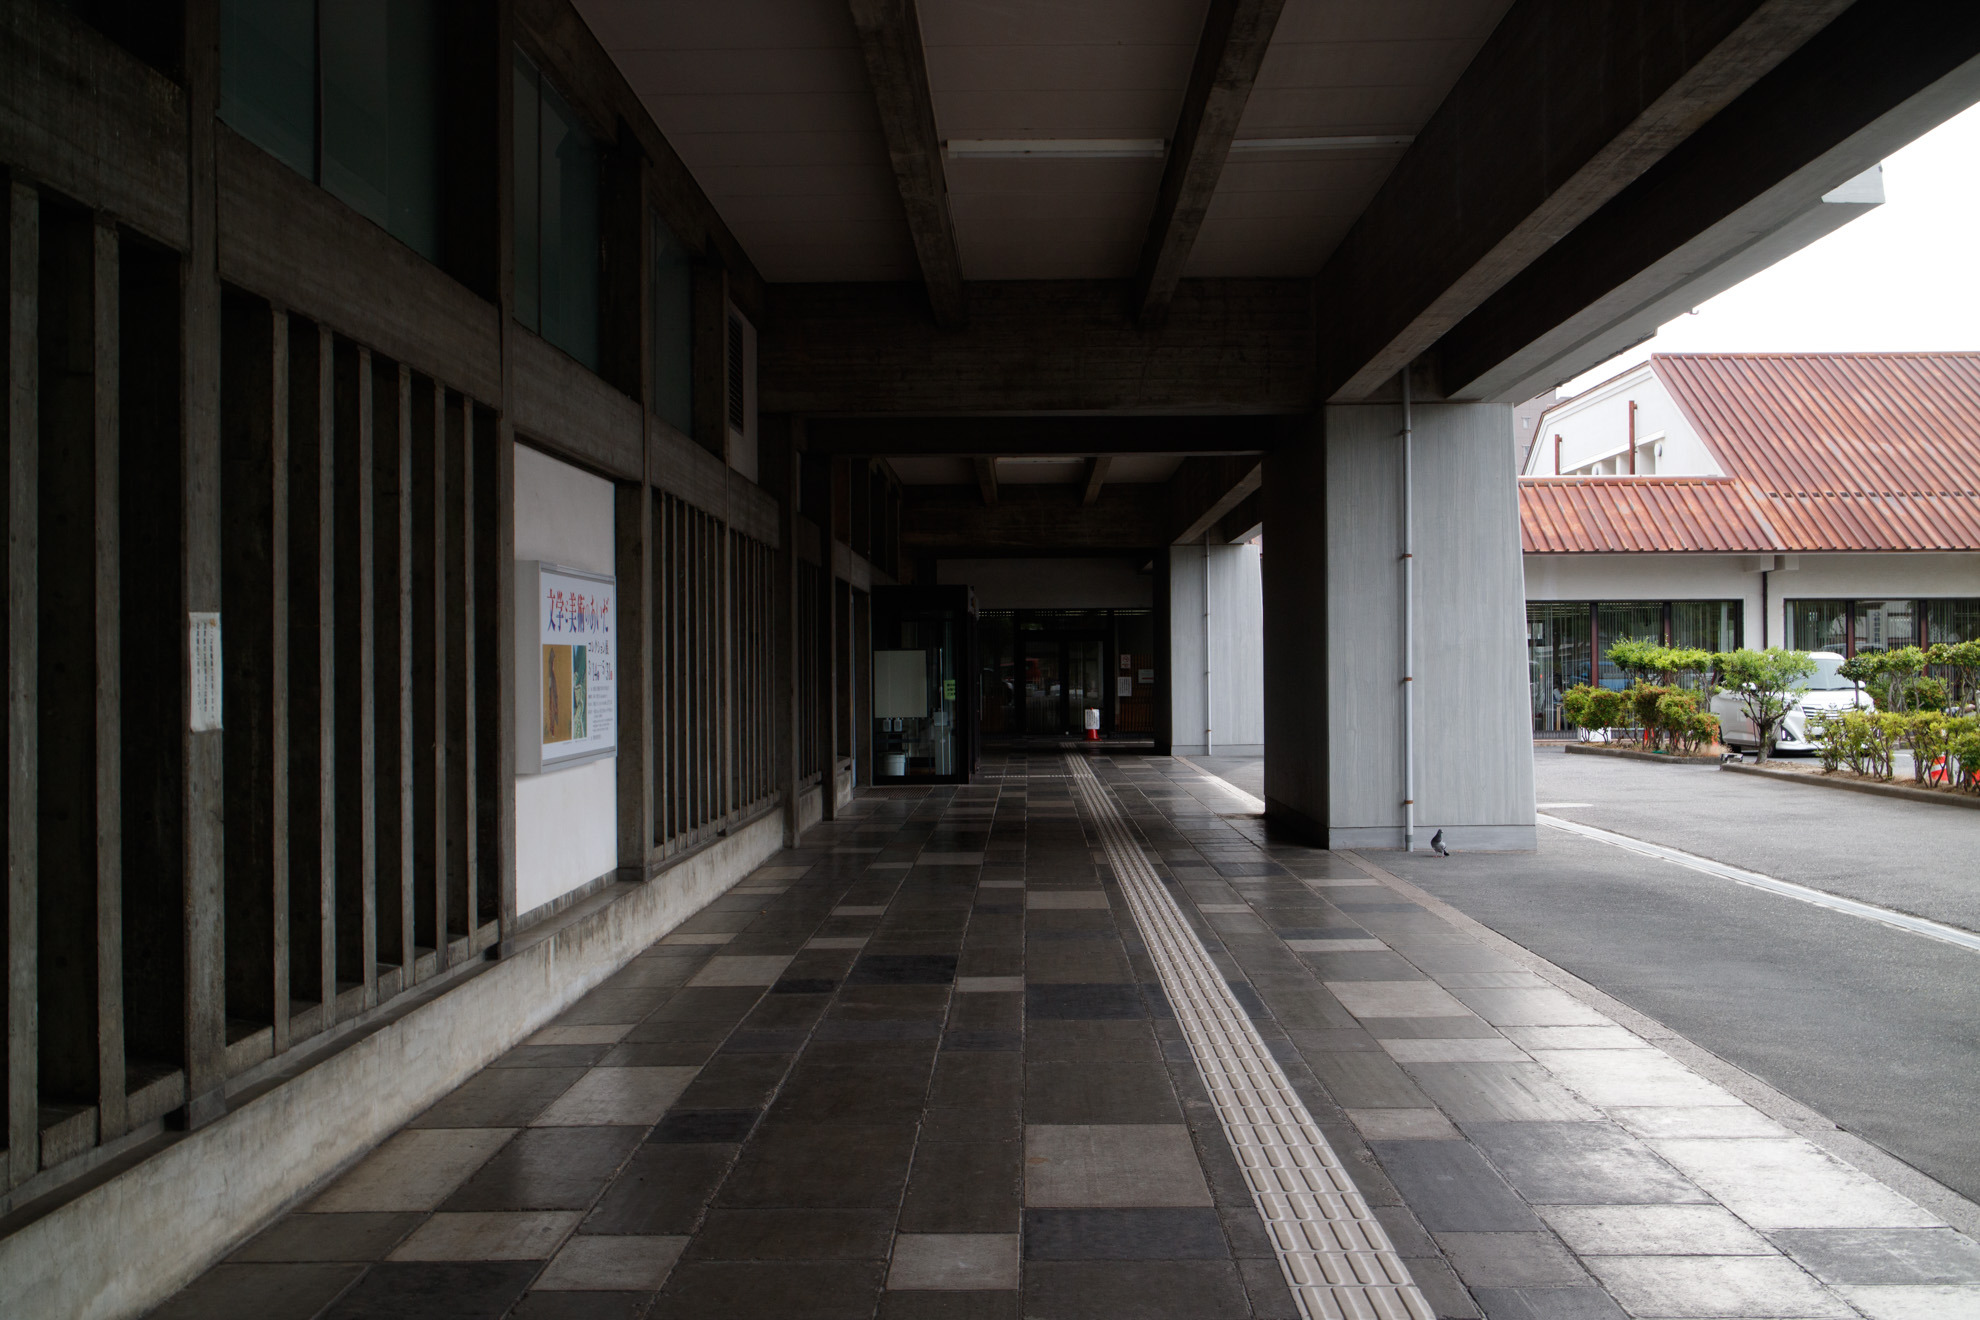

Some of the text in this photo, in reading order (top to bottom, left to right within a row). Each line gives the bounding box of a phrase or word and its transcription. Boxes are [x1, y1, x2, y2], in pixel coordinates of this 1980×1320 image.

[547, 588, 609, 634] 文学と美術のあいだ
